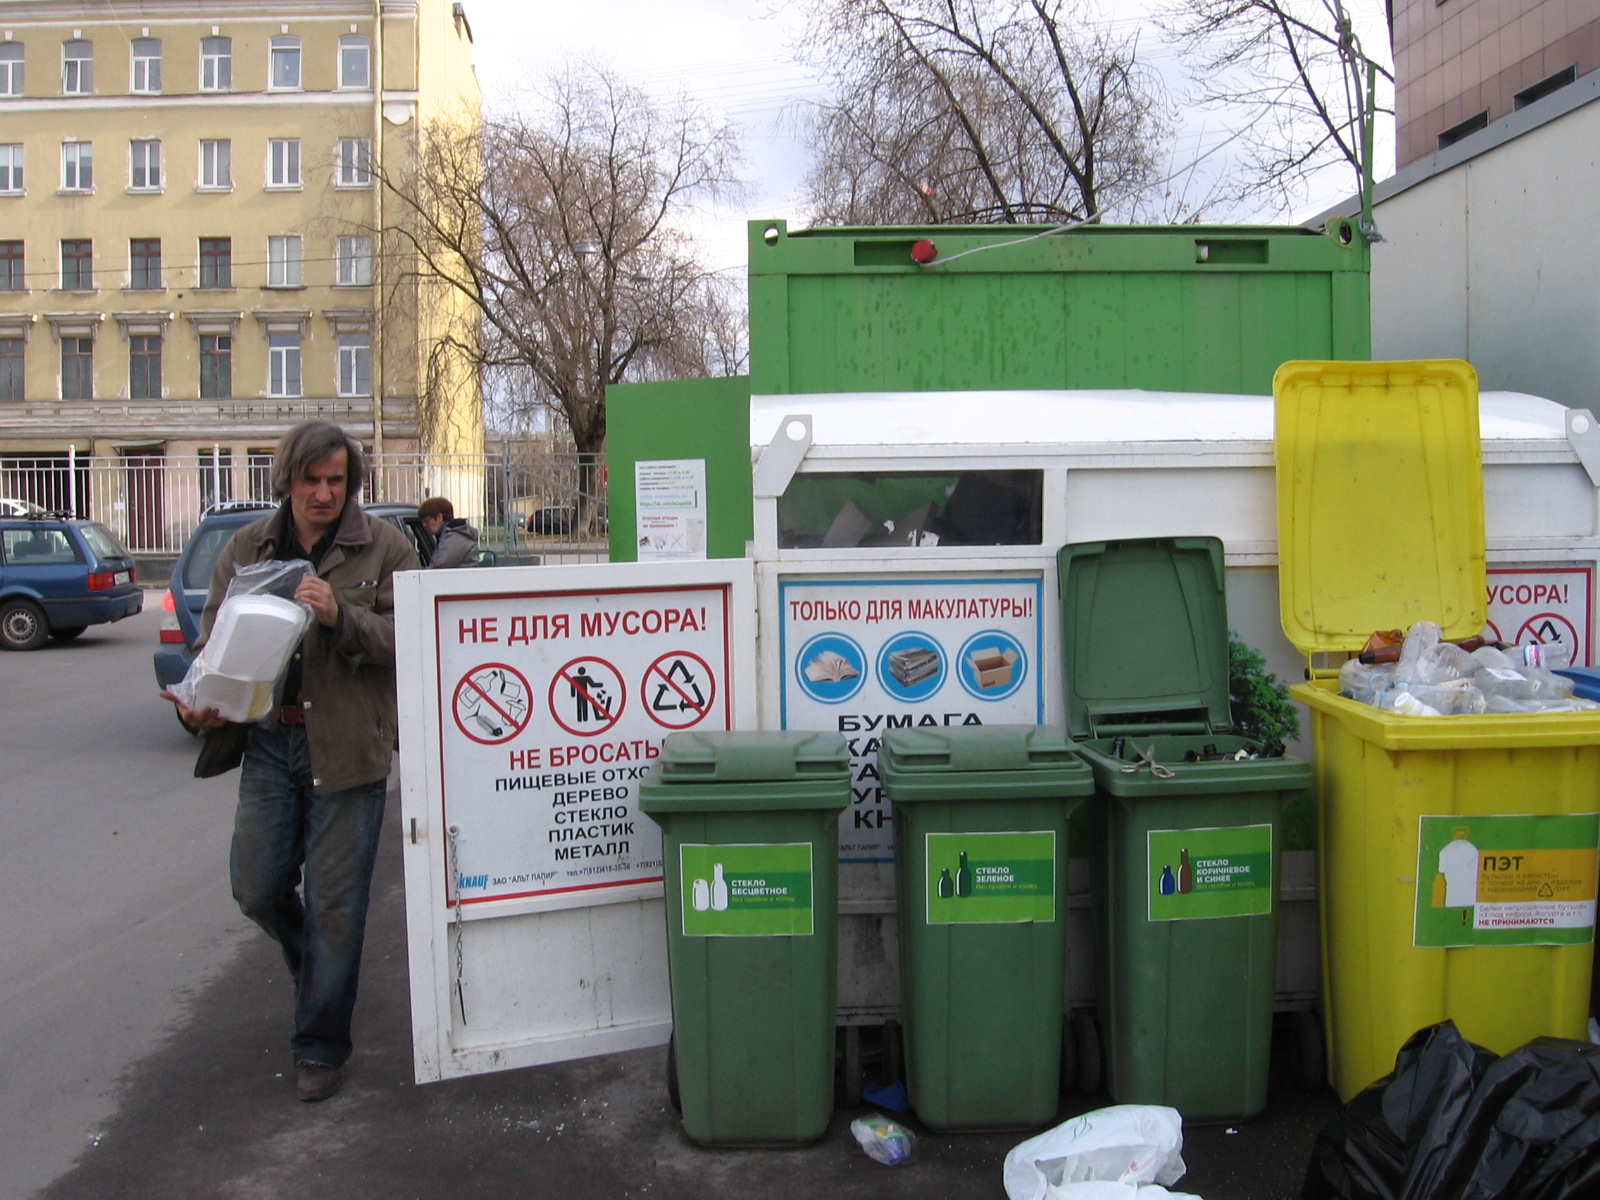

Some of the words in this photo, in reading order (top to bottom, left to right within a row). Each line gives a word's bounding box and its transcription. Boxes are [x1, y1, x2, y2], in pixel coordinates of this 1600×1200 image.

[1486, 584, 1568, 605] УСОРА!
[790, 600, 861, 621] ТОЛЬКО
[865, 600, 901, 624] ДЛЯ
[908, 597, 1033, 620] МАКУЛАТУРЫ!
[458, 617, 498, 644] НЕ
[508, 614, 570, 646] ДЛЯ
[580, 608, 707, 638] МУСОРА!
[838, 713, 983, 732] БУМАГА
[509, 749, 541, 770] НЕ
[495, 770, 596, 792] ПИЩЕВЫЕ
[602, 766, 650, 782] ОТХО
[552, 787, 629, 808] ДЕРЕВО
[554, 806, 628, 824] СТЕКЛО
[549, 822, 634, 843] ПЛАСТИК
[555, 841, 629, 861] МЕТАЛЛ
[975, 867, 1010, 875] СТЕКЛО
[1196, 859, 1229, 868] СТЕКЛО
[1196, 866, 1251, 875] КОРИЧНЕВОЕ
[1483, 856, 1524, 871] ПЭТ
[492, 877, 507, 885] ЗАО
[975, 875, 1015, 883] ЗЕЛЕНОЕ
[1204, 875, 1232, 883] СИНЕЕ
[731, 888, 788, 896] БЕСЦВЕТНОЕ
[1491, 918, 1555, 926] ПРИНИМАЮТСЯ
